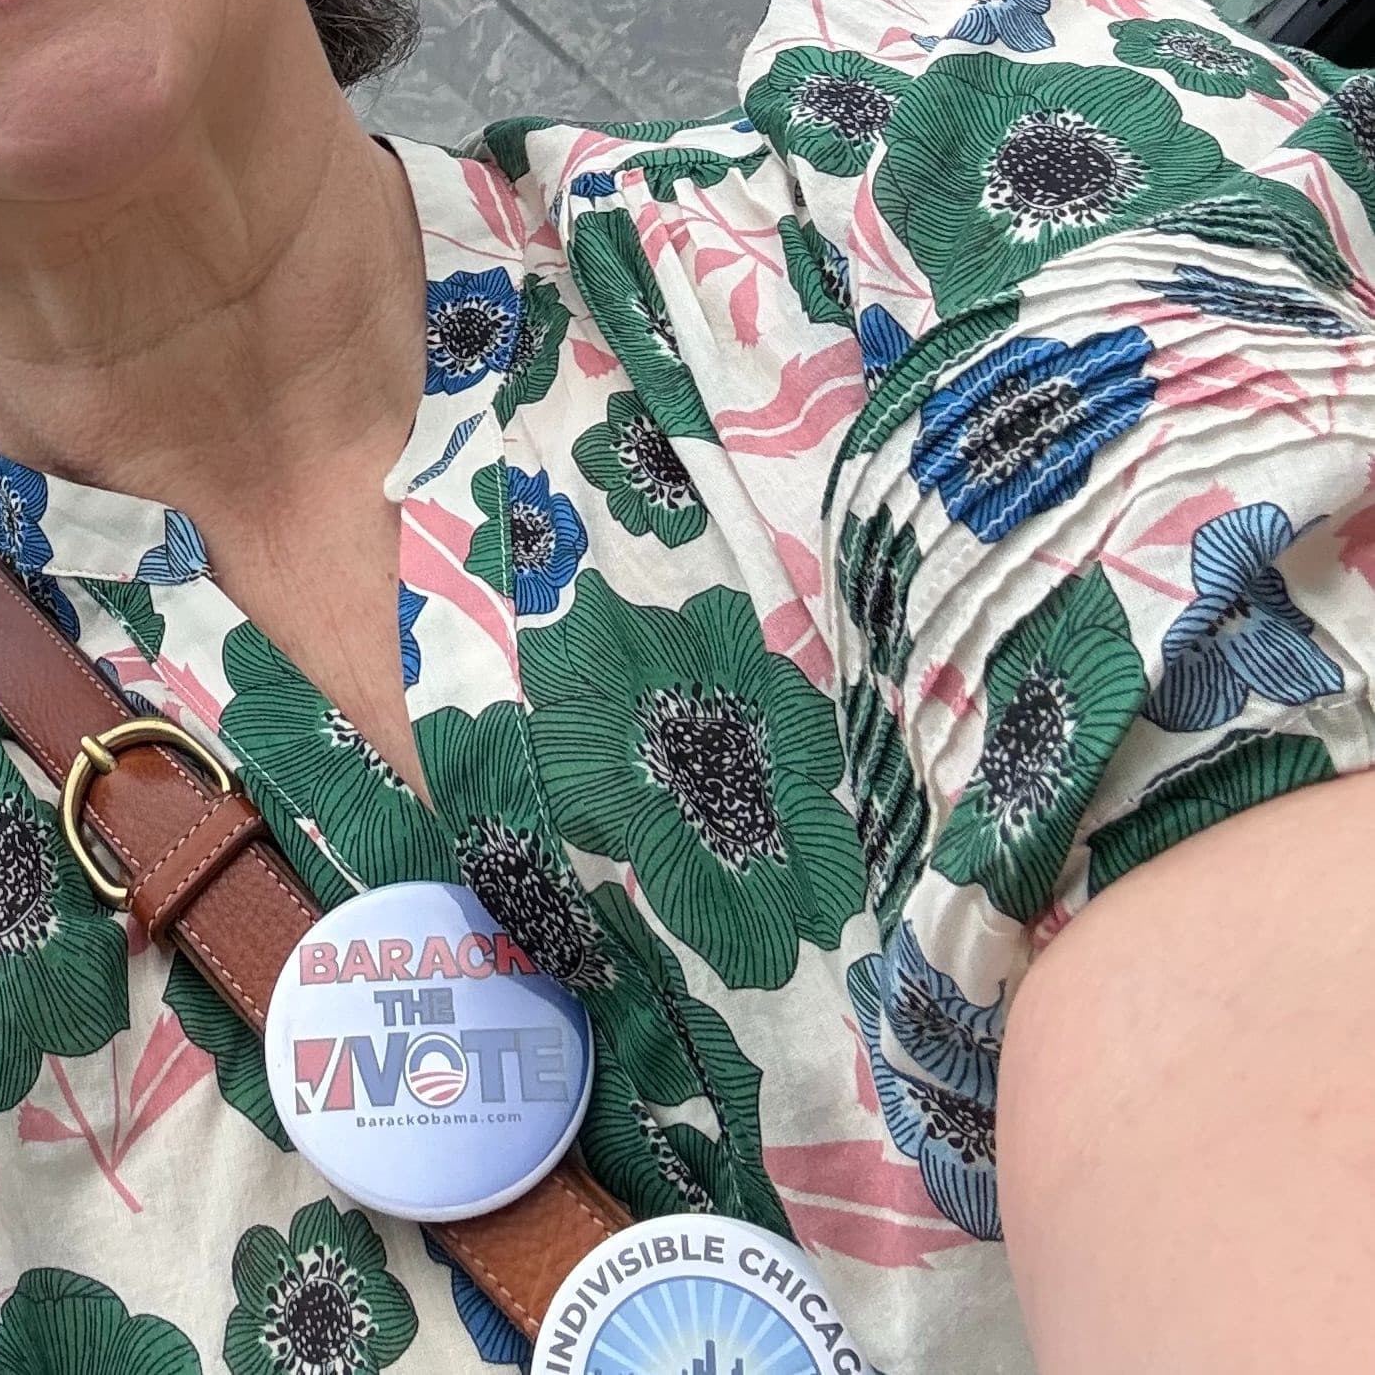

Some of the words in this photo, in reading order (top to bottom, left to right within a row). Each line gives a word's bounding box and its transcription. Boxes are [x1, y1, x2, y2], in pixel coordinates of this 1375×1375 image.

[299, 932, 538, 986] BARACK
[373, 987, 455, 1026] THE
[346, 1026, 570, 1109] VOTE
[356, 1111, 522, 1127] BarackObama.com
[545, 1234, 726, 1375] INDIVISIBLE
